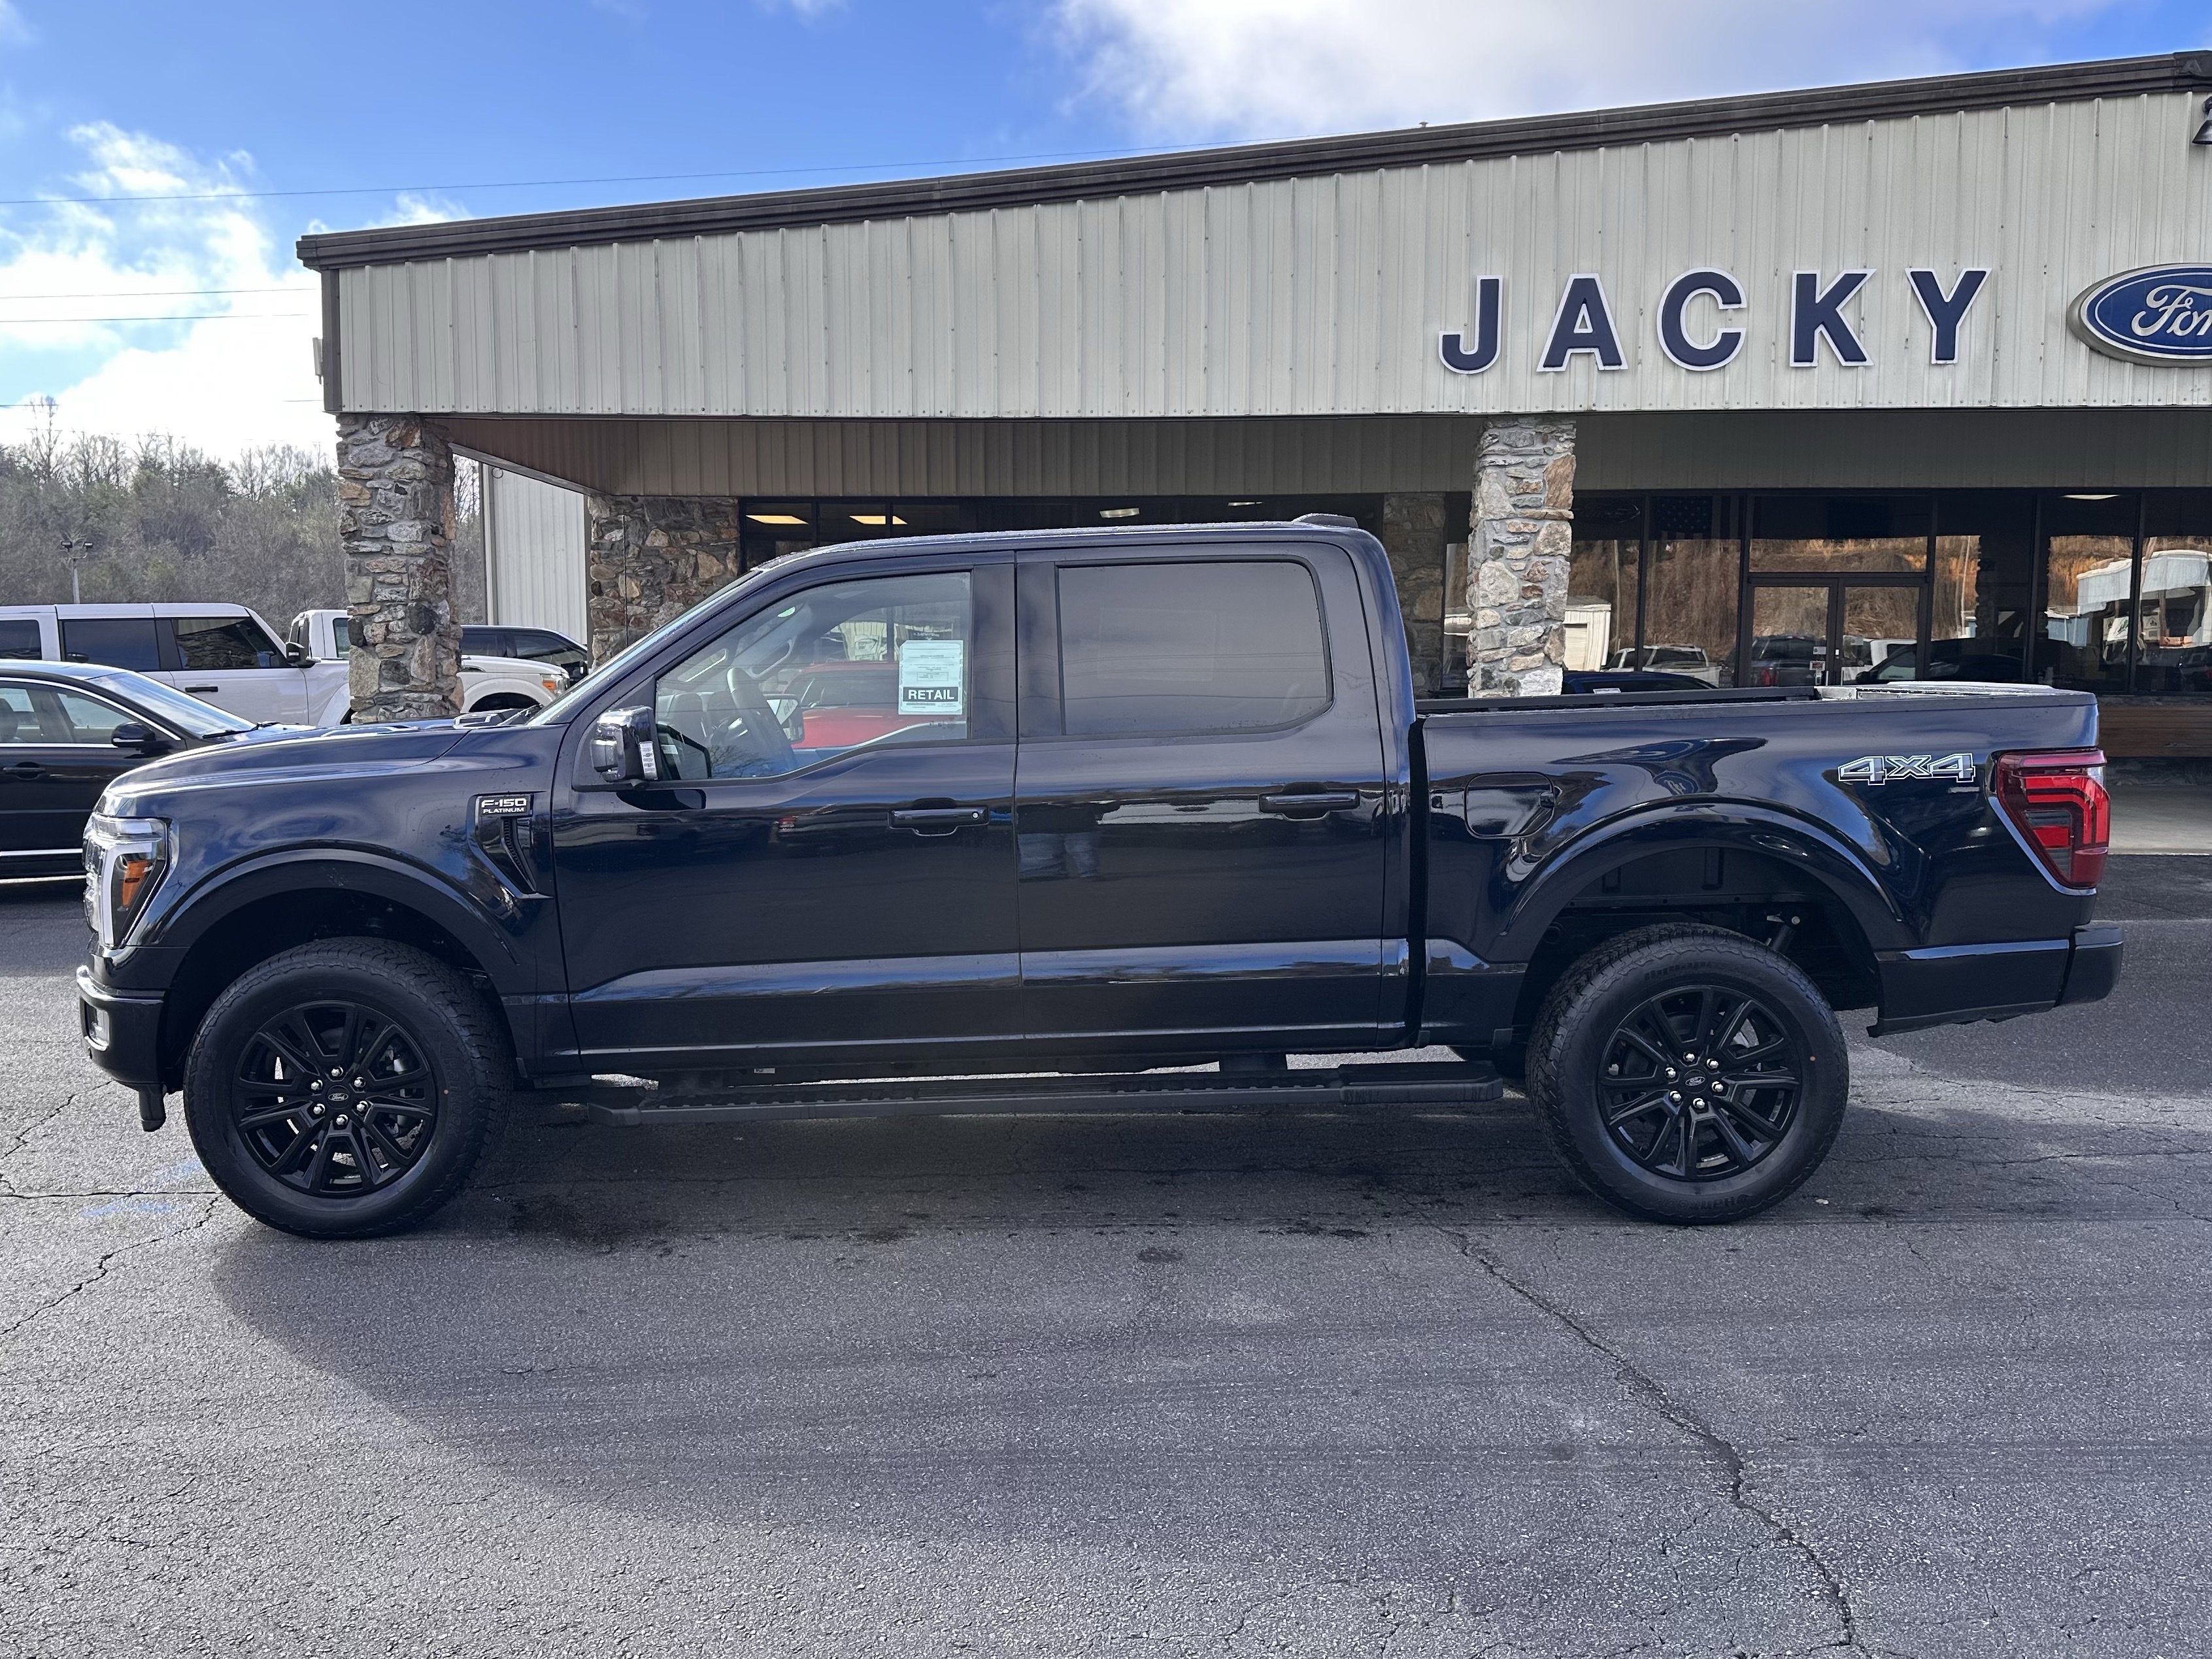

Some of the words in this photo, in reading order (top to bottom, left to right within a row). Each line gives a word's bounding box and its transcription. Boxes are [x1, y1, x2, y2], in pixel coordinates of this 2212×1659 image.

[1439, 267, 1992, 374] JACKY
[2132, 284, 2212, 337] For
[908, 689, 954, 700] RETAIL
[481, 797, 527, 808] F-150
